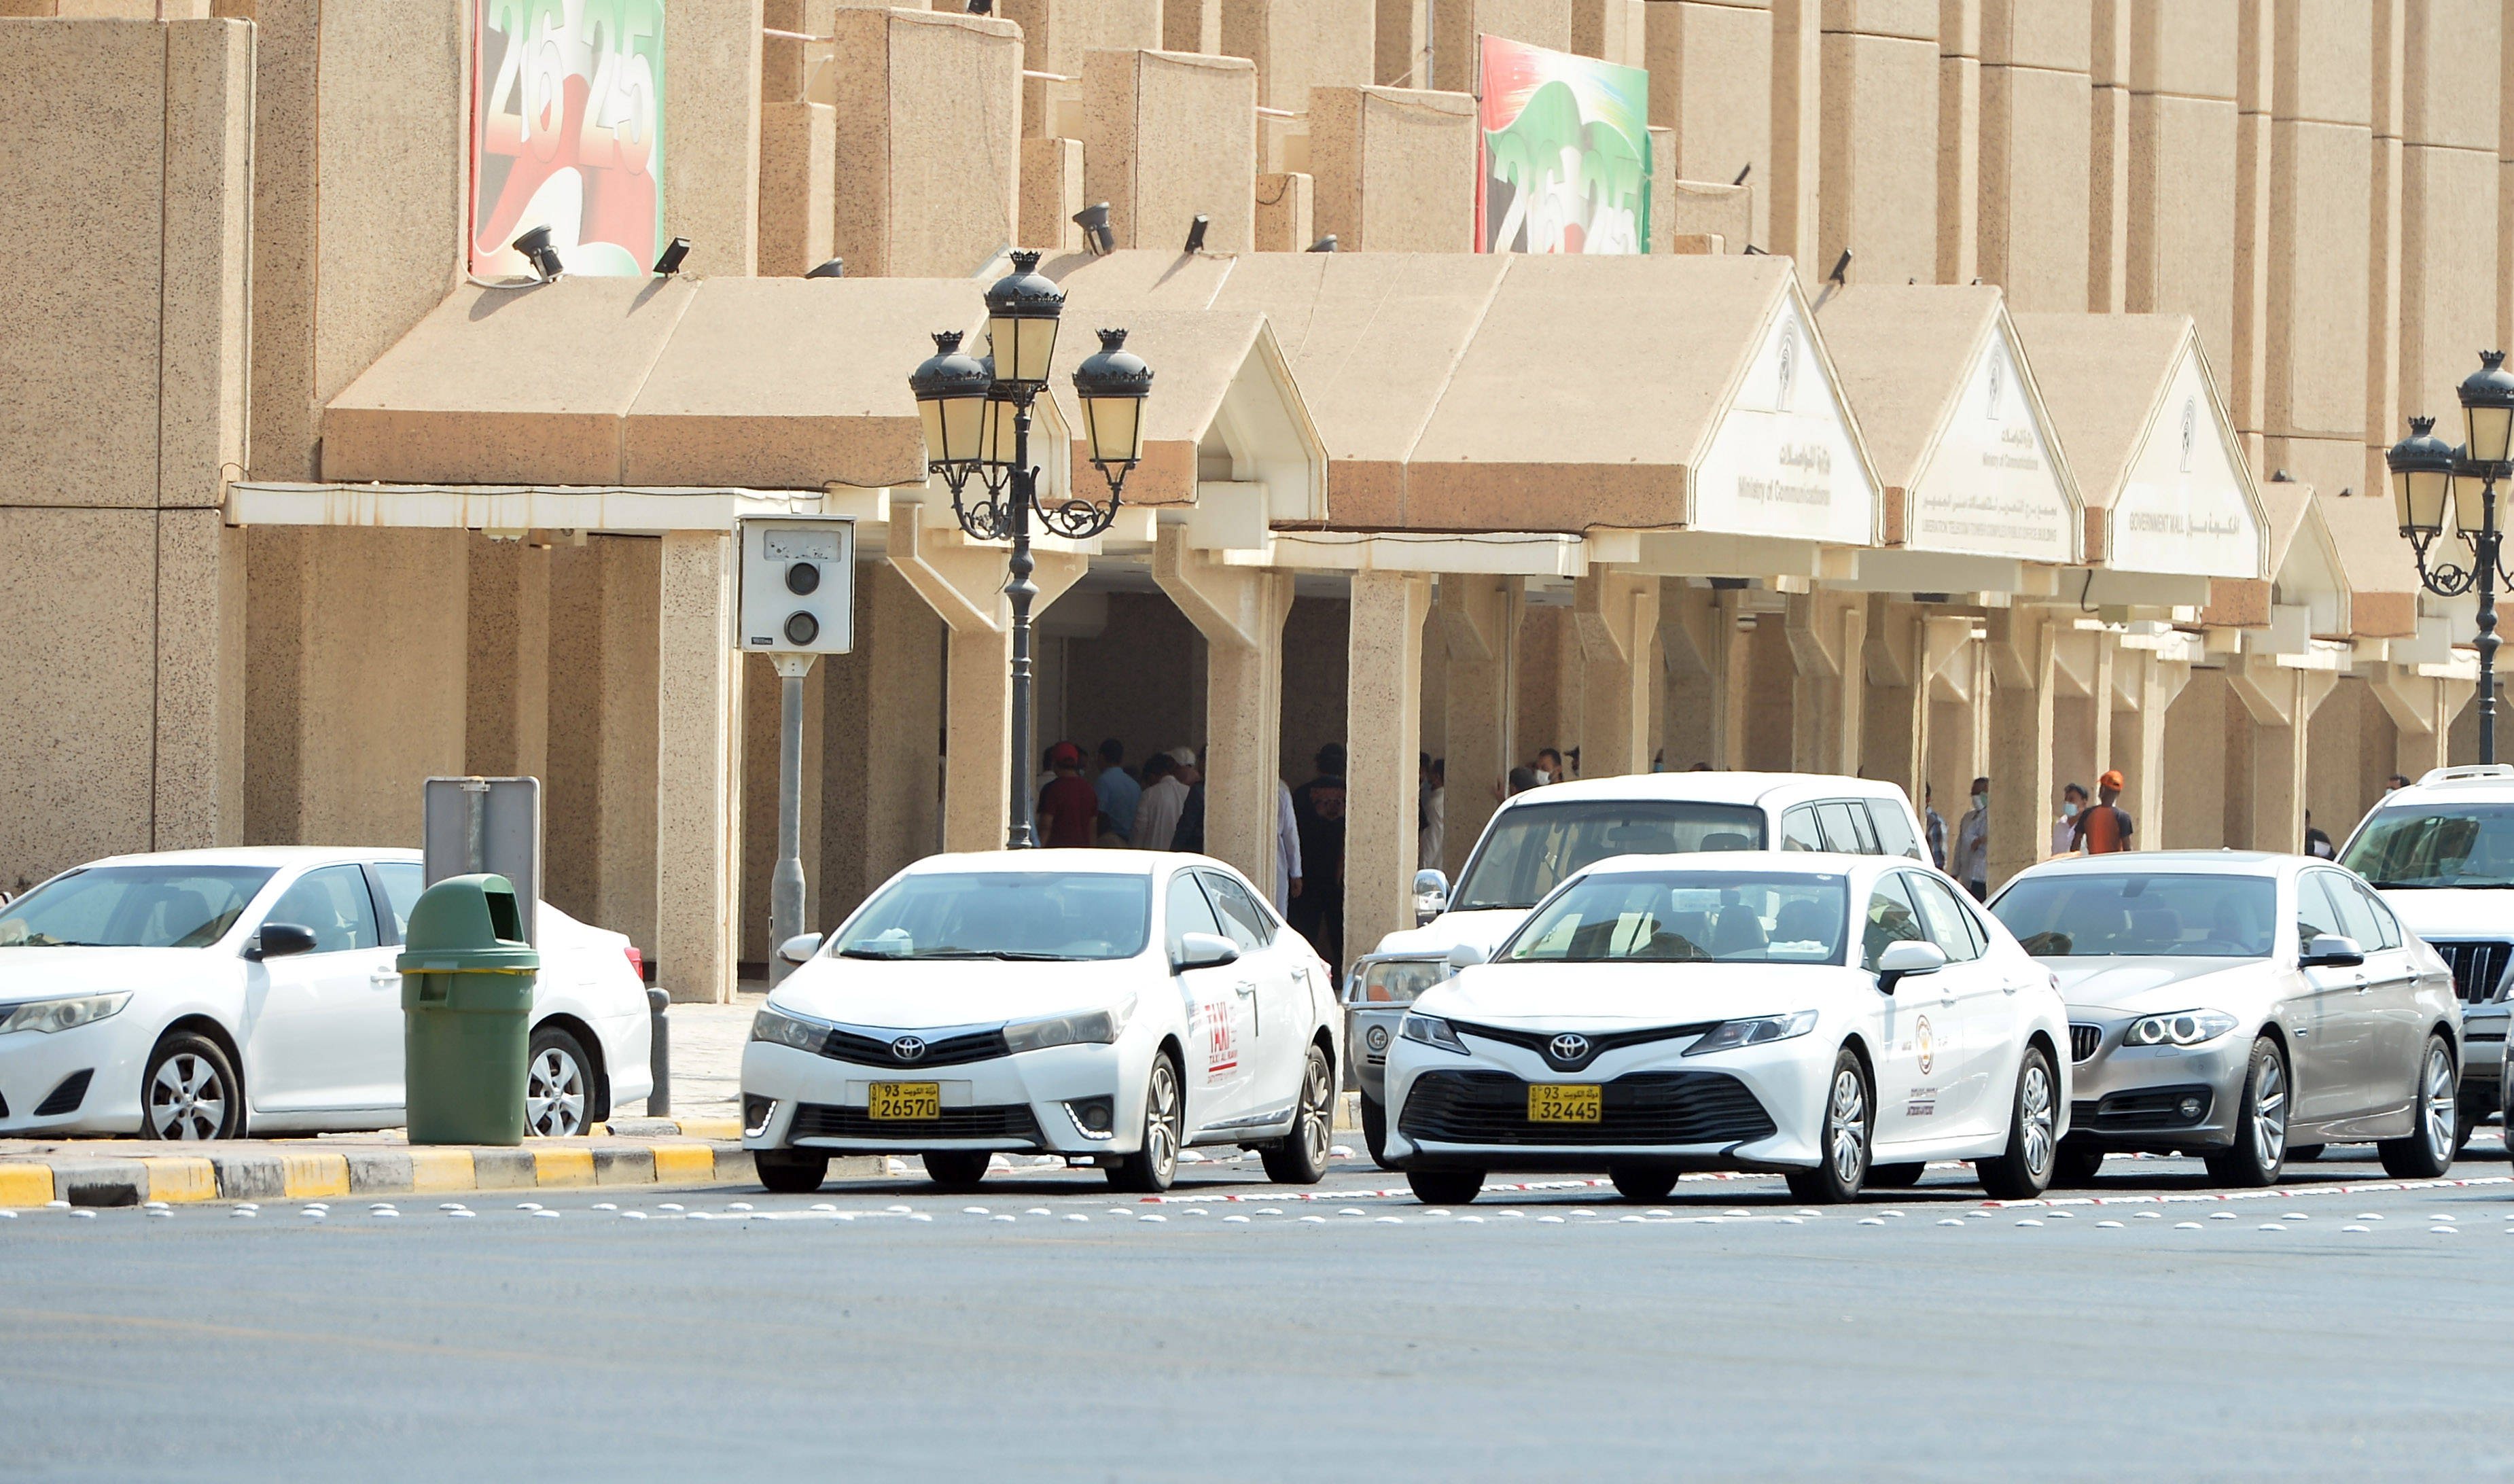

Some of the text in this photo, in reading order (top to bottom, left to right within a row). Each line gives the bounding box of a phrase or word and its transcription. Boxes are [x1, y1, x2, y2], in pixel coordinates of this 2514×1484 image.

[1982, 451, 1998, 470] Ministry
[1738, 476, 1765, 505] Ministry
[1767, 479, 1773, 501] of
[2129, 512, 2184, 534] GOVERNMENT MALL
[1205, 1001, 1230, 1054] TAXI
[885, 1084, 900, 1097] 93
[1544, 1086, 1559, 1099] 93
[881, 1099, 936, 1116] 26570
[1540, 1101, 1597, 1120] 32445
